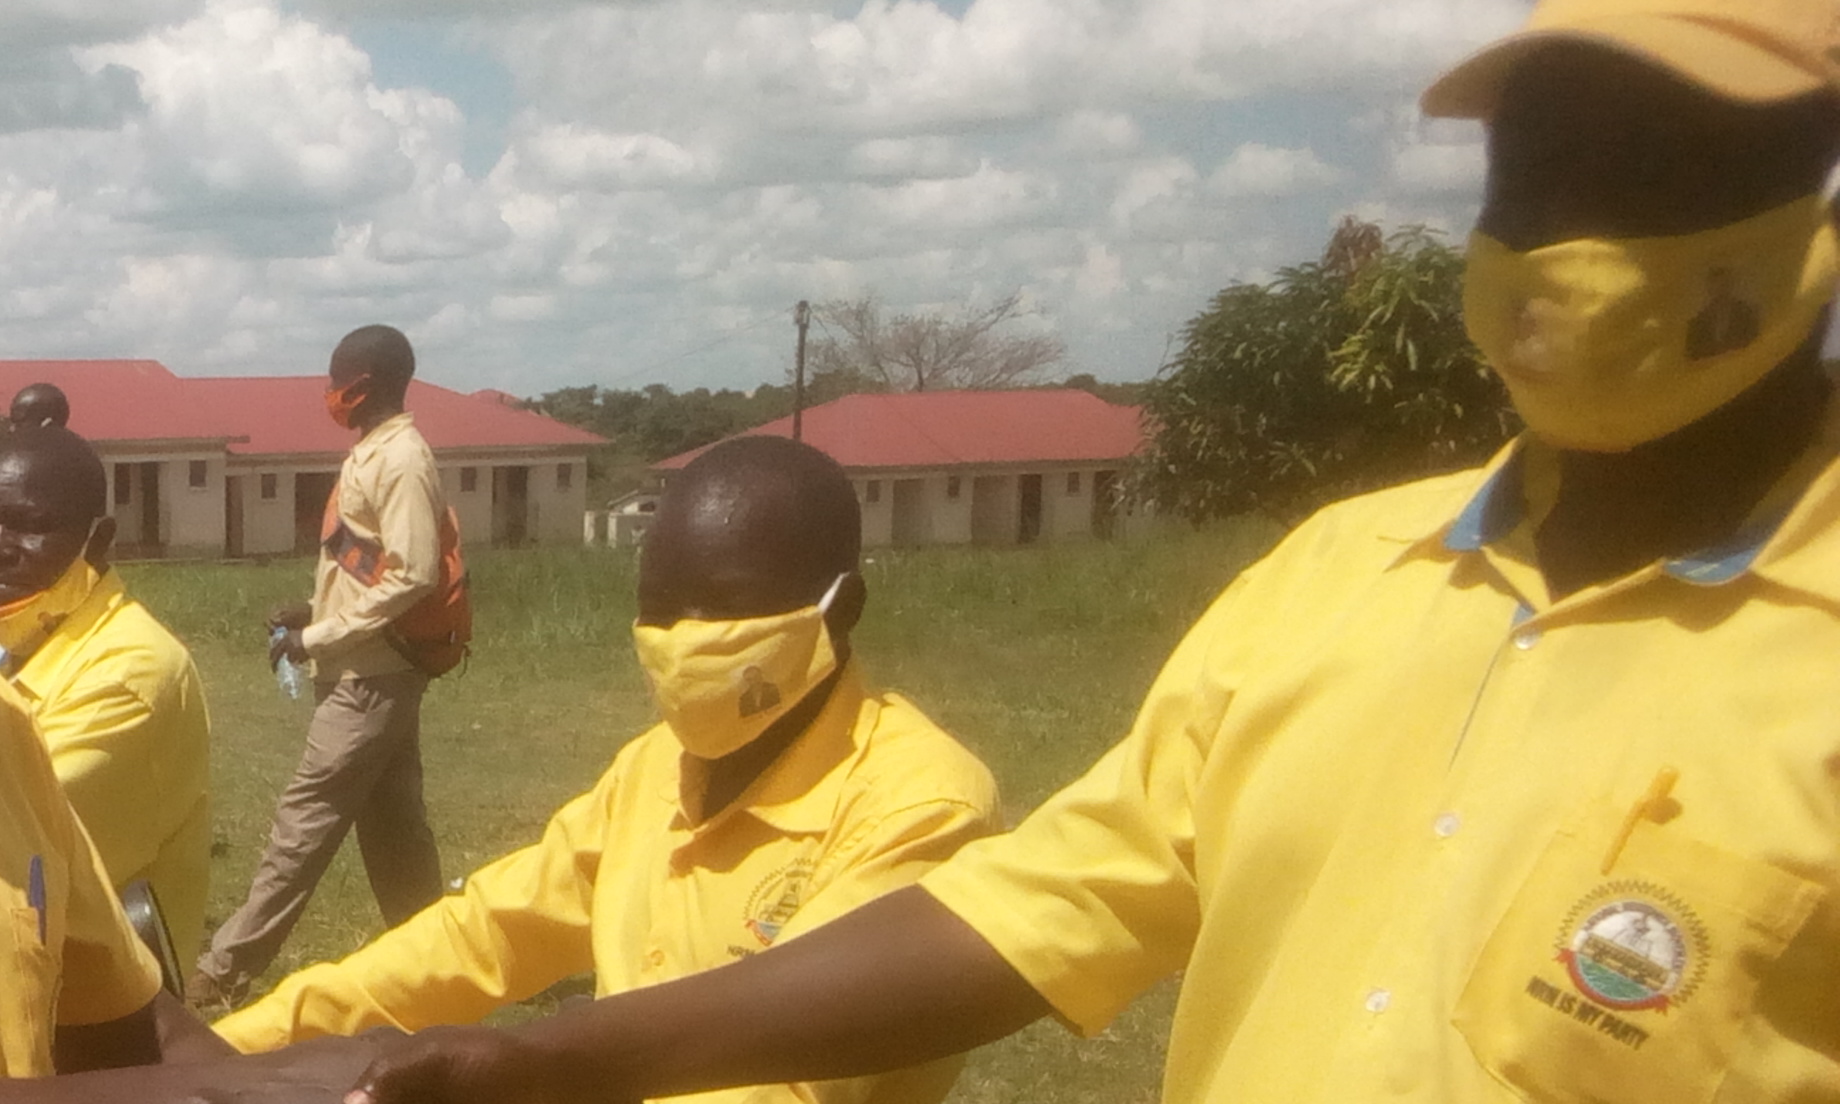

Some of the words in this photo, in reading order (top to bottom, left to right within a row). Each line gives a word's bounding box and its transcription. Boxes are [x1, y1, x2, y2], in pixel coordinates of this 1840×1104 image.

[1556, 992, 1578, 1015] IS
[1573, 1001, 1605, 1026] MY
[1597, 1013, 1650, 1050] PARTY
